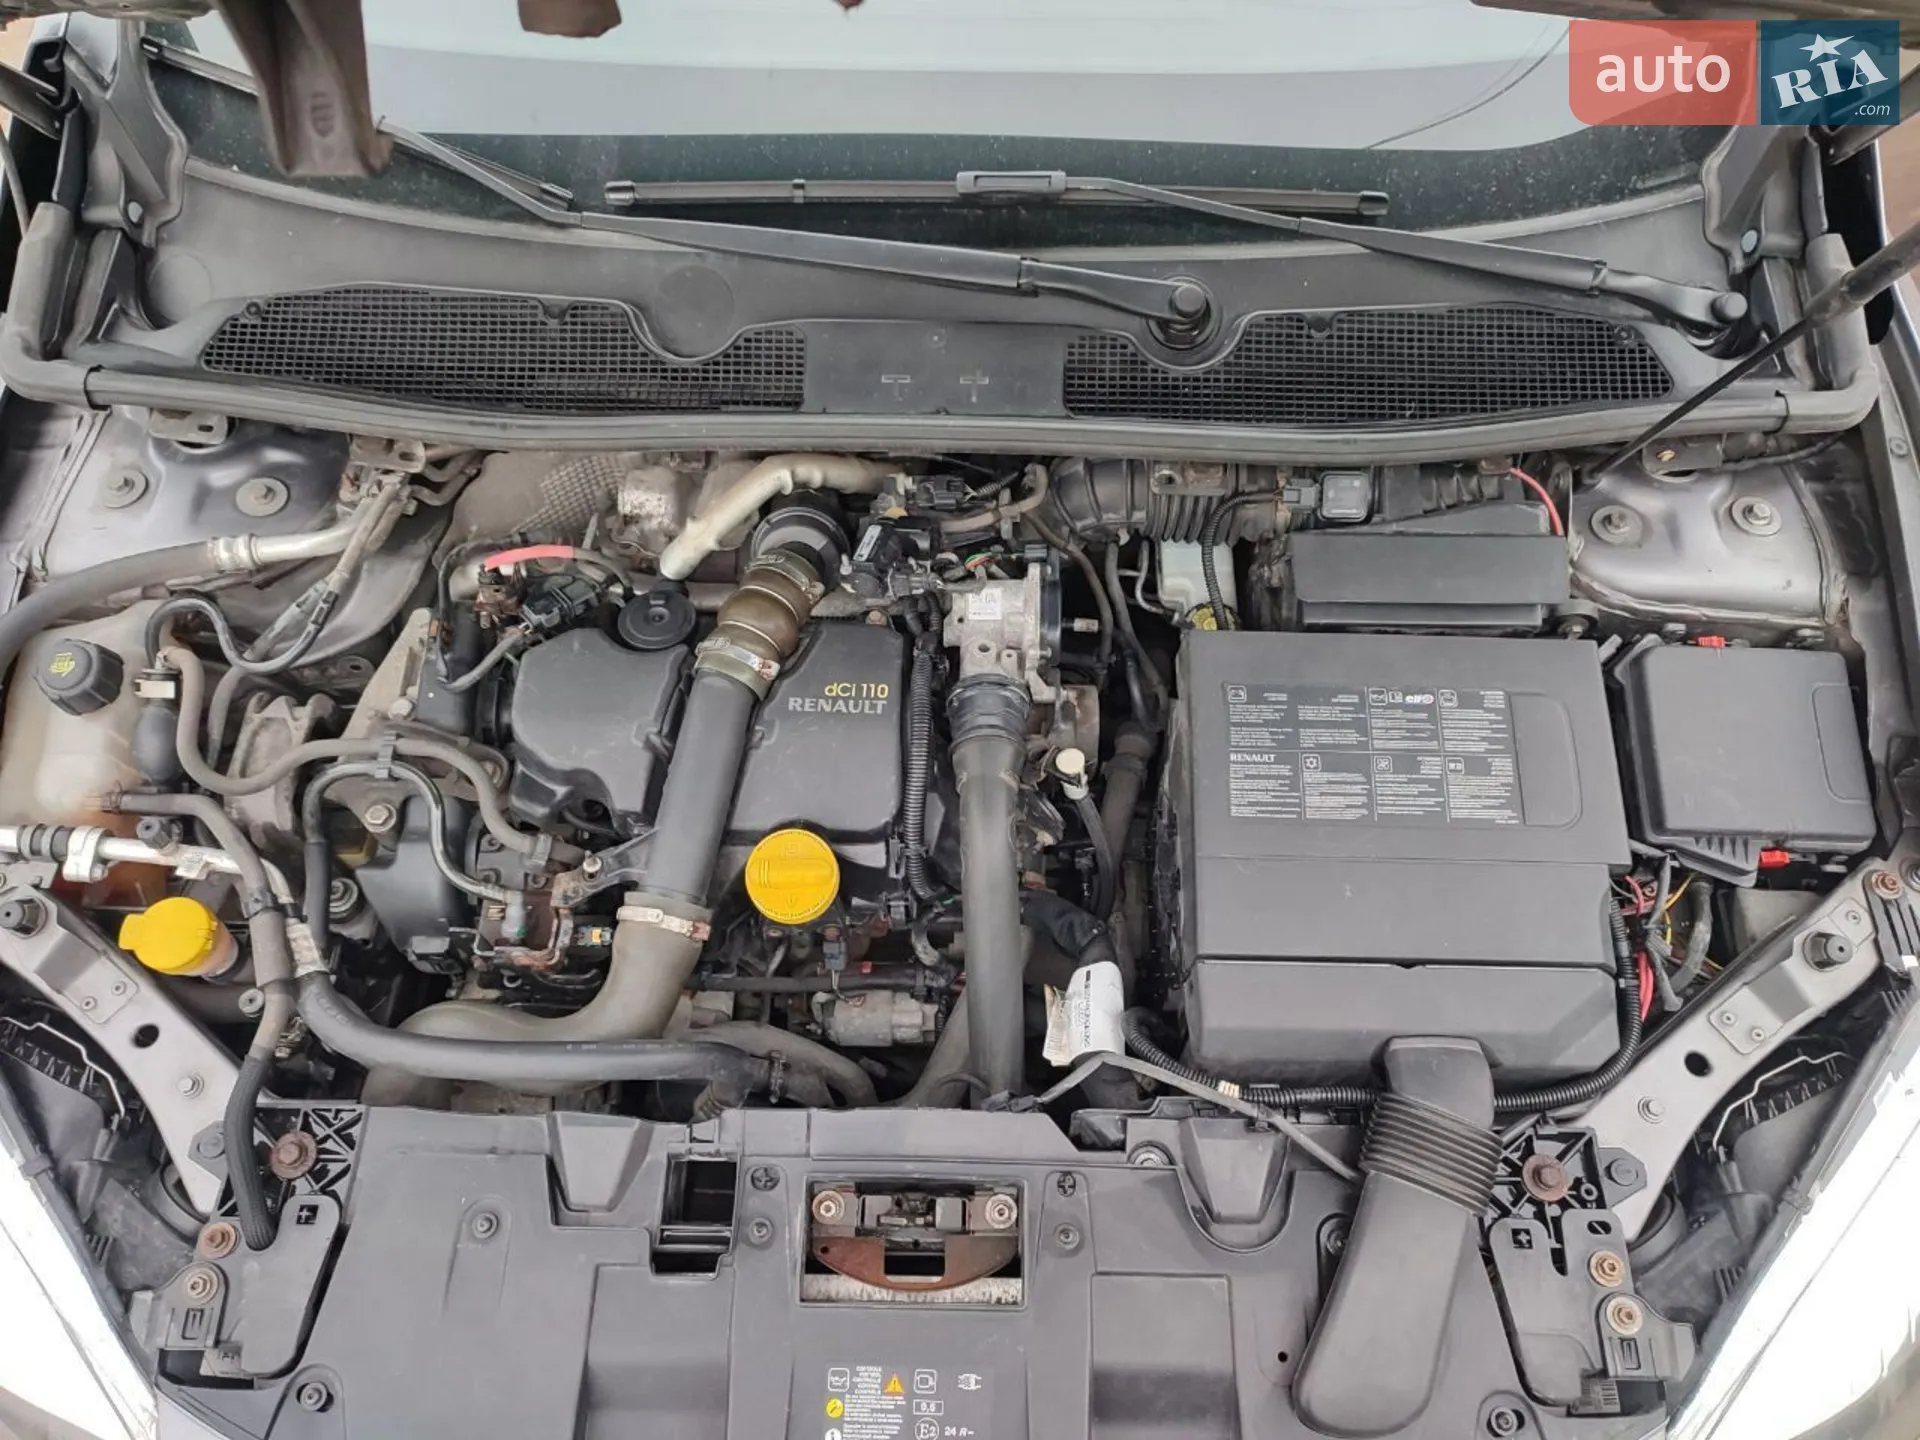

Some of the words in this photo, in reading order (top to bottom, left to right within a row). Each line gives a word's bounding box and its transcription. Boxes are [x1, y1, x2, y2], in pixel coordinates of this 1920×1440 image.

[824, 682, 856, 698] dCi
[861, 683, 889, 698] 110
[788, 697, 887, 714] RENAULT
[1229, 752, 1277, 763] RENAULT
[920, 1423, 937, 1439] E2
[944, 1426, 957, 1437] 24
